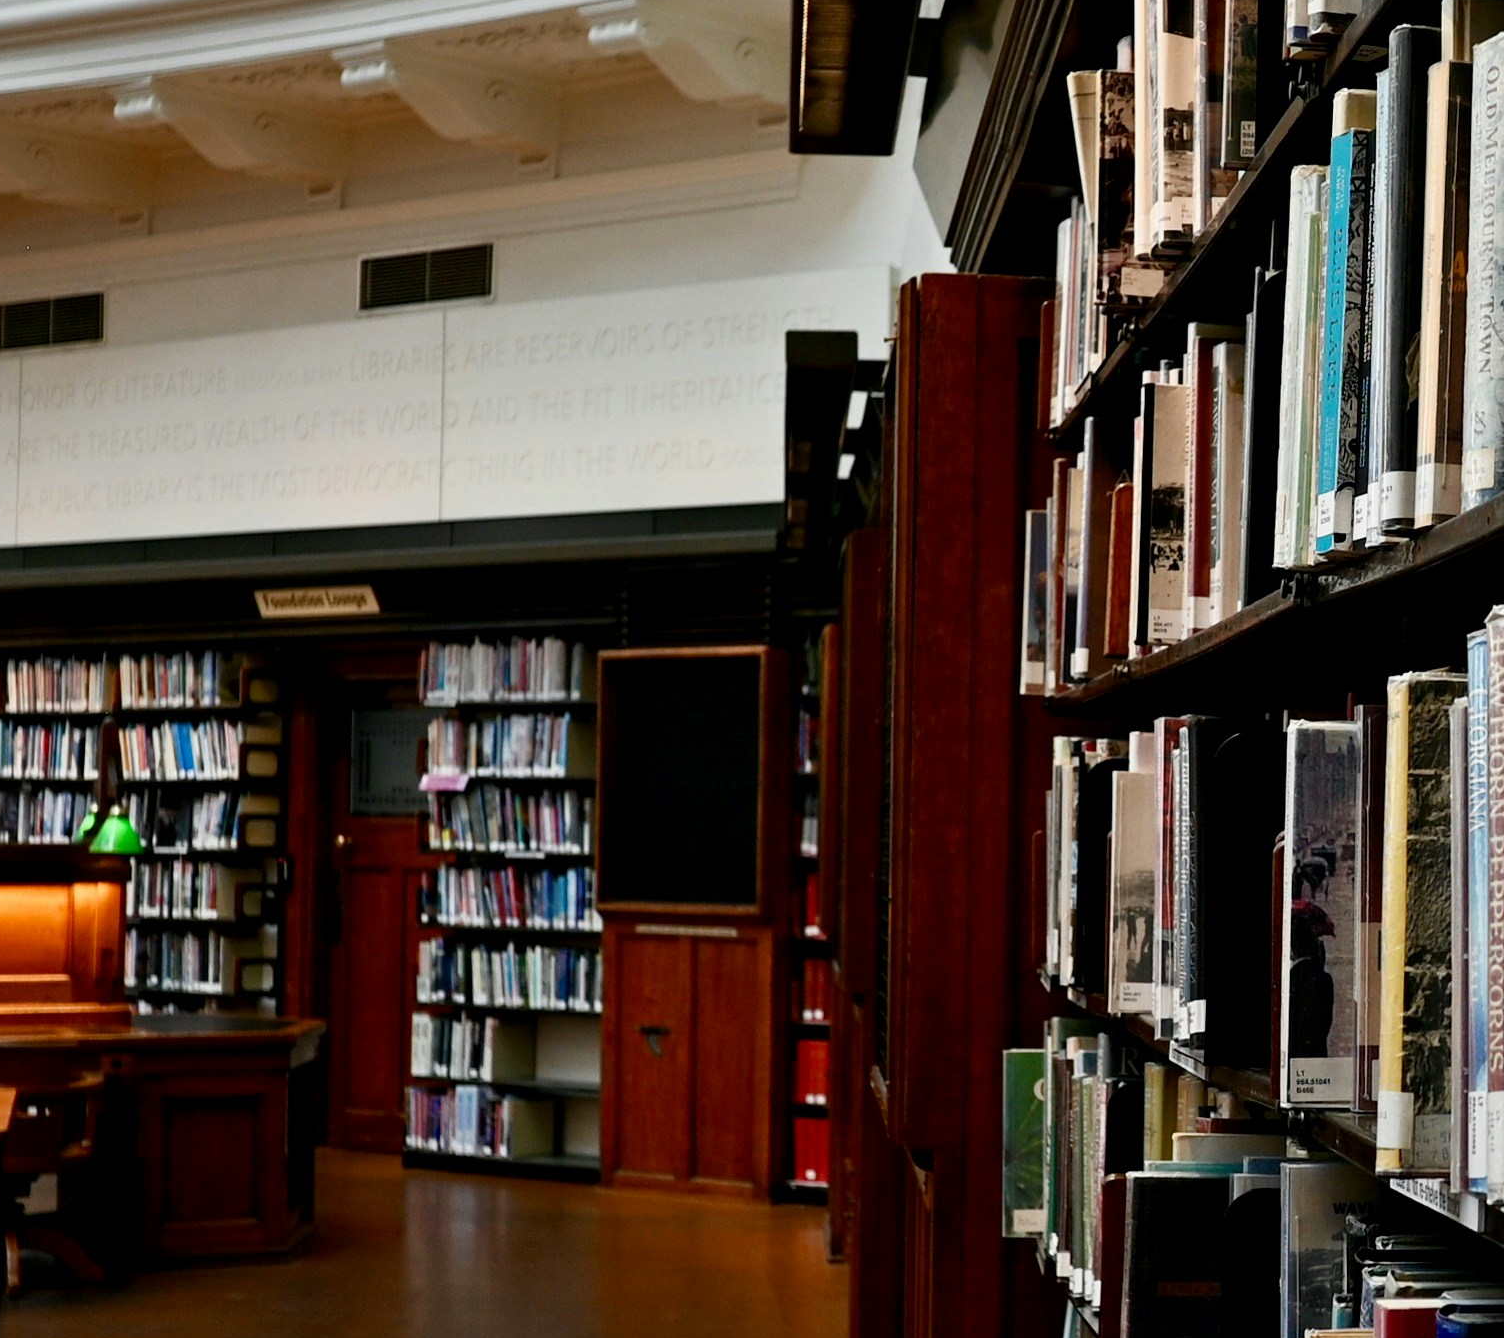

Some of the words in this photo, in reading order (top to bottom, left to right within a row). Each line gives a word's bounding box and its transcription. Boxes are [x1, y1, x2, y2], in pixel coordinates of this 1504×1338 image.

[1485, 66, 1500, 120] OLD
[1479, 127, 1500, 287] MELBOURNE
[1477, 295, 1496, 375] TOWN
[262, 591, 324, 610] Foundation
[325, 589, 367, 610] Lounge
[1468, 688, 1488, 834] GEORGIANA
